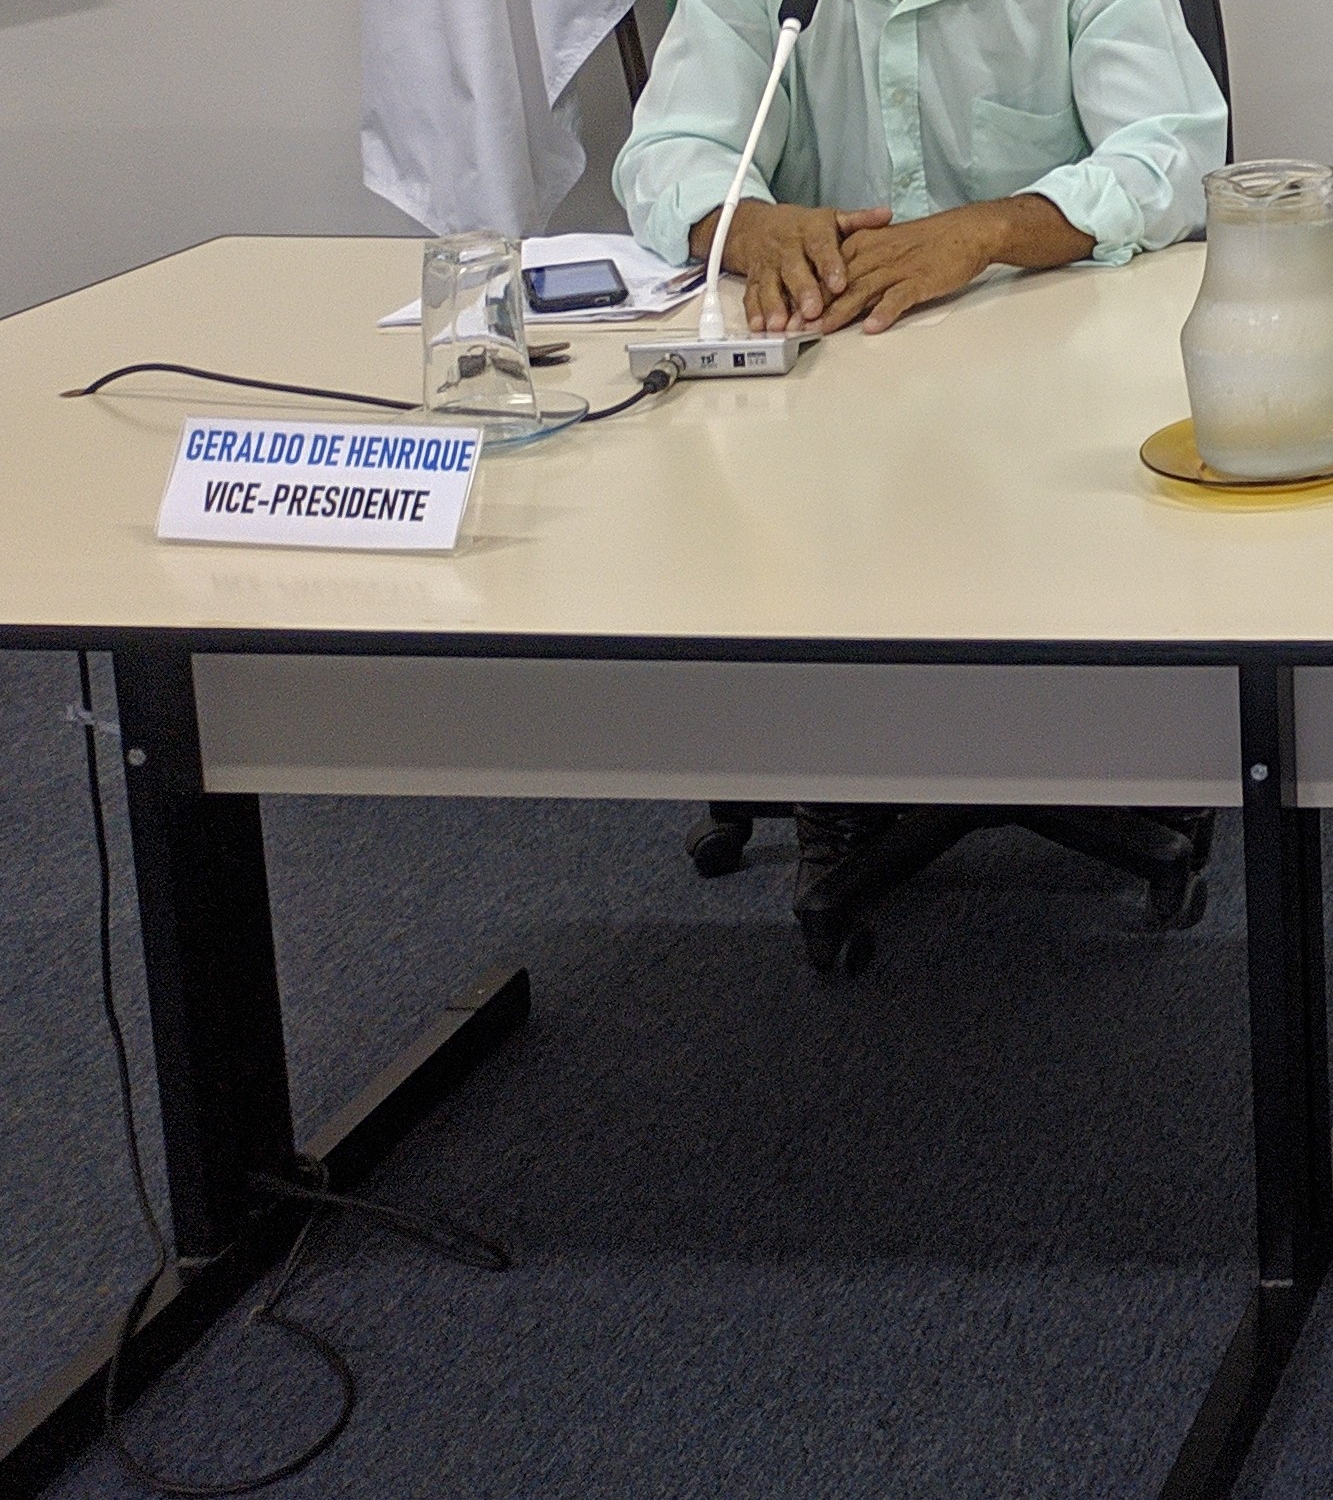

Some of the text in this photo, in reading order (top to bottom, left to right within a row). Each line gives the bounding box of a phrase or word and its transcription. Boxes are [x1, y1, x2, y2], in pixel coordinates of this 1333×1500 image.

[186, 430, 475, 473] GERALDO DE HENRIQUE
[204, 481, 431, 522] VICE-PRESIDENTE
